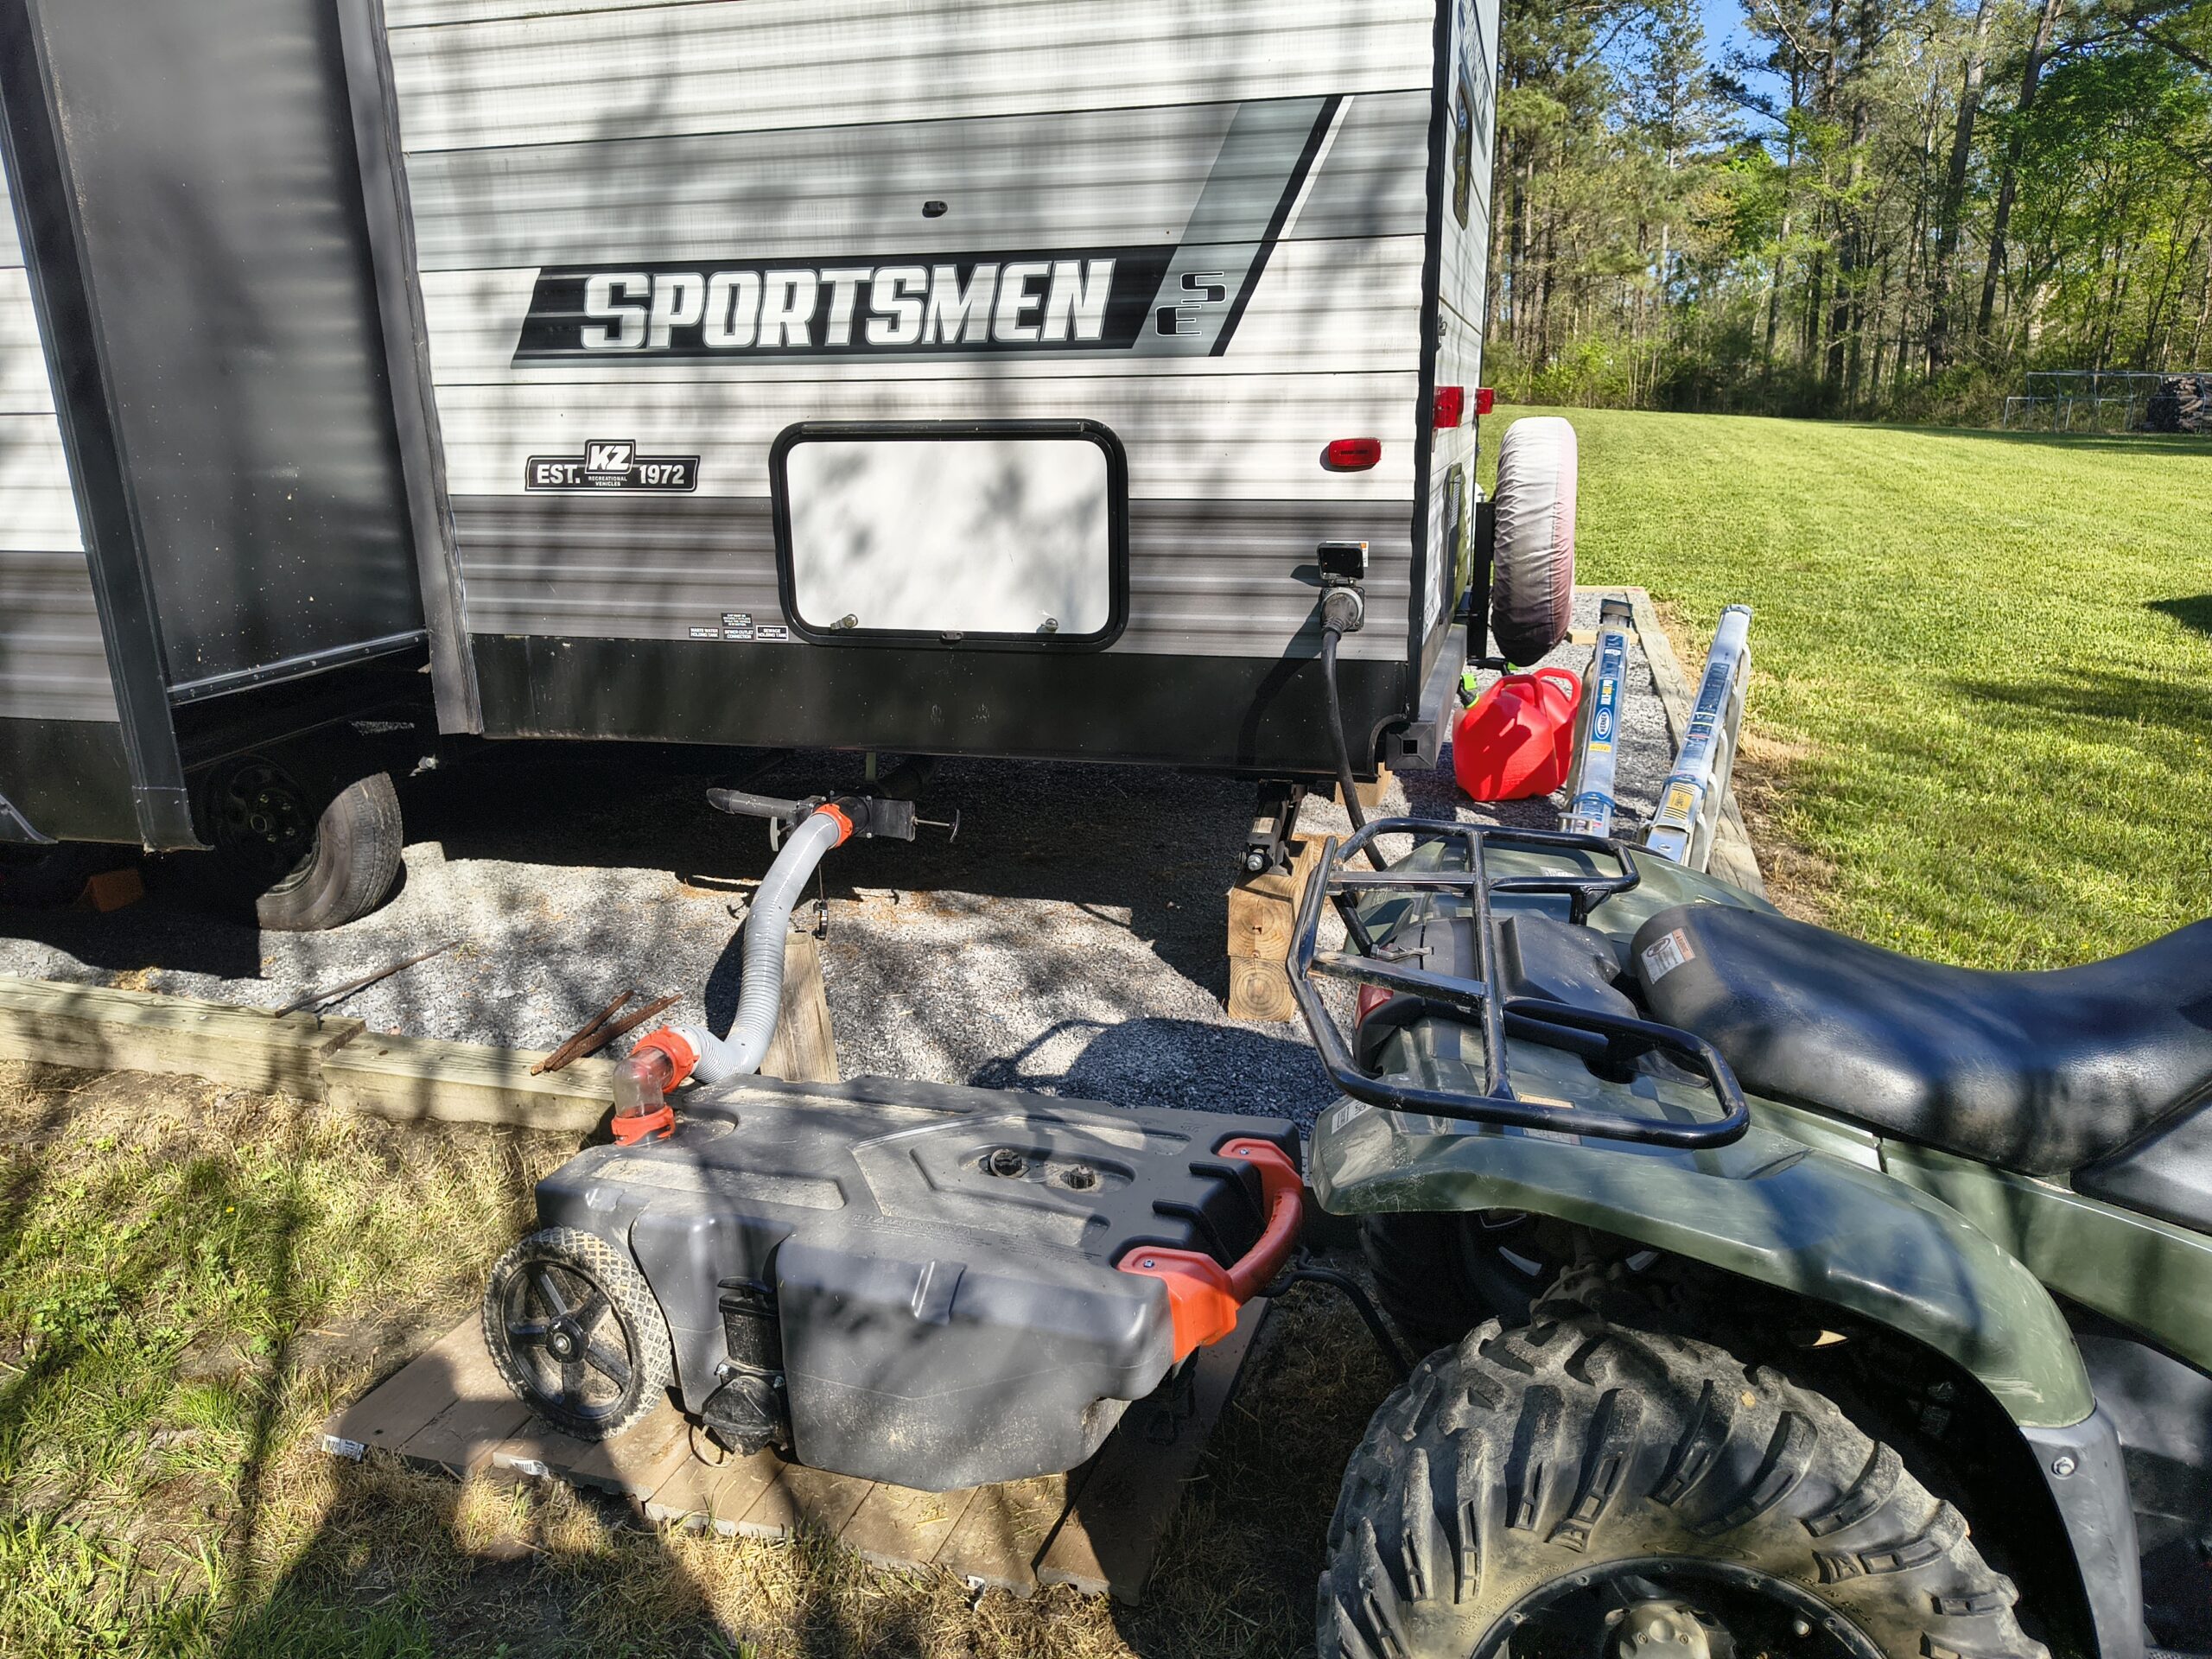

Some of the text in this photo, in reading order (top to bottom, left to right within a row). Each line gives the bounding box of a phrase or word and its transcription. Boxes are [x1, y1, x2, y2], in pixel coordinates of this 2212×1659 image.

[582, 258, 1117, 350] SPORTSMEN
[588, 445, 631, 471] KZ
[537, 464, 685, 485] EST. 1972
